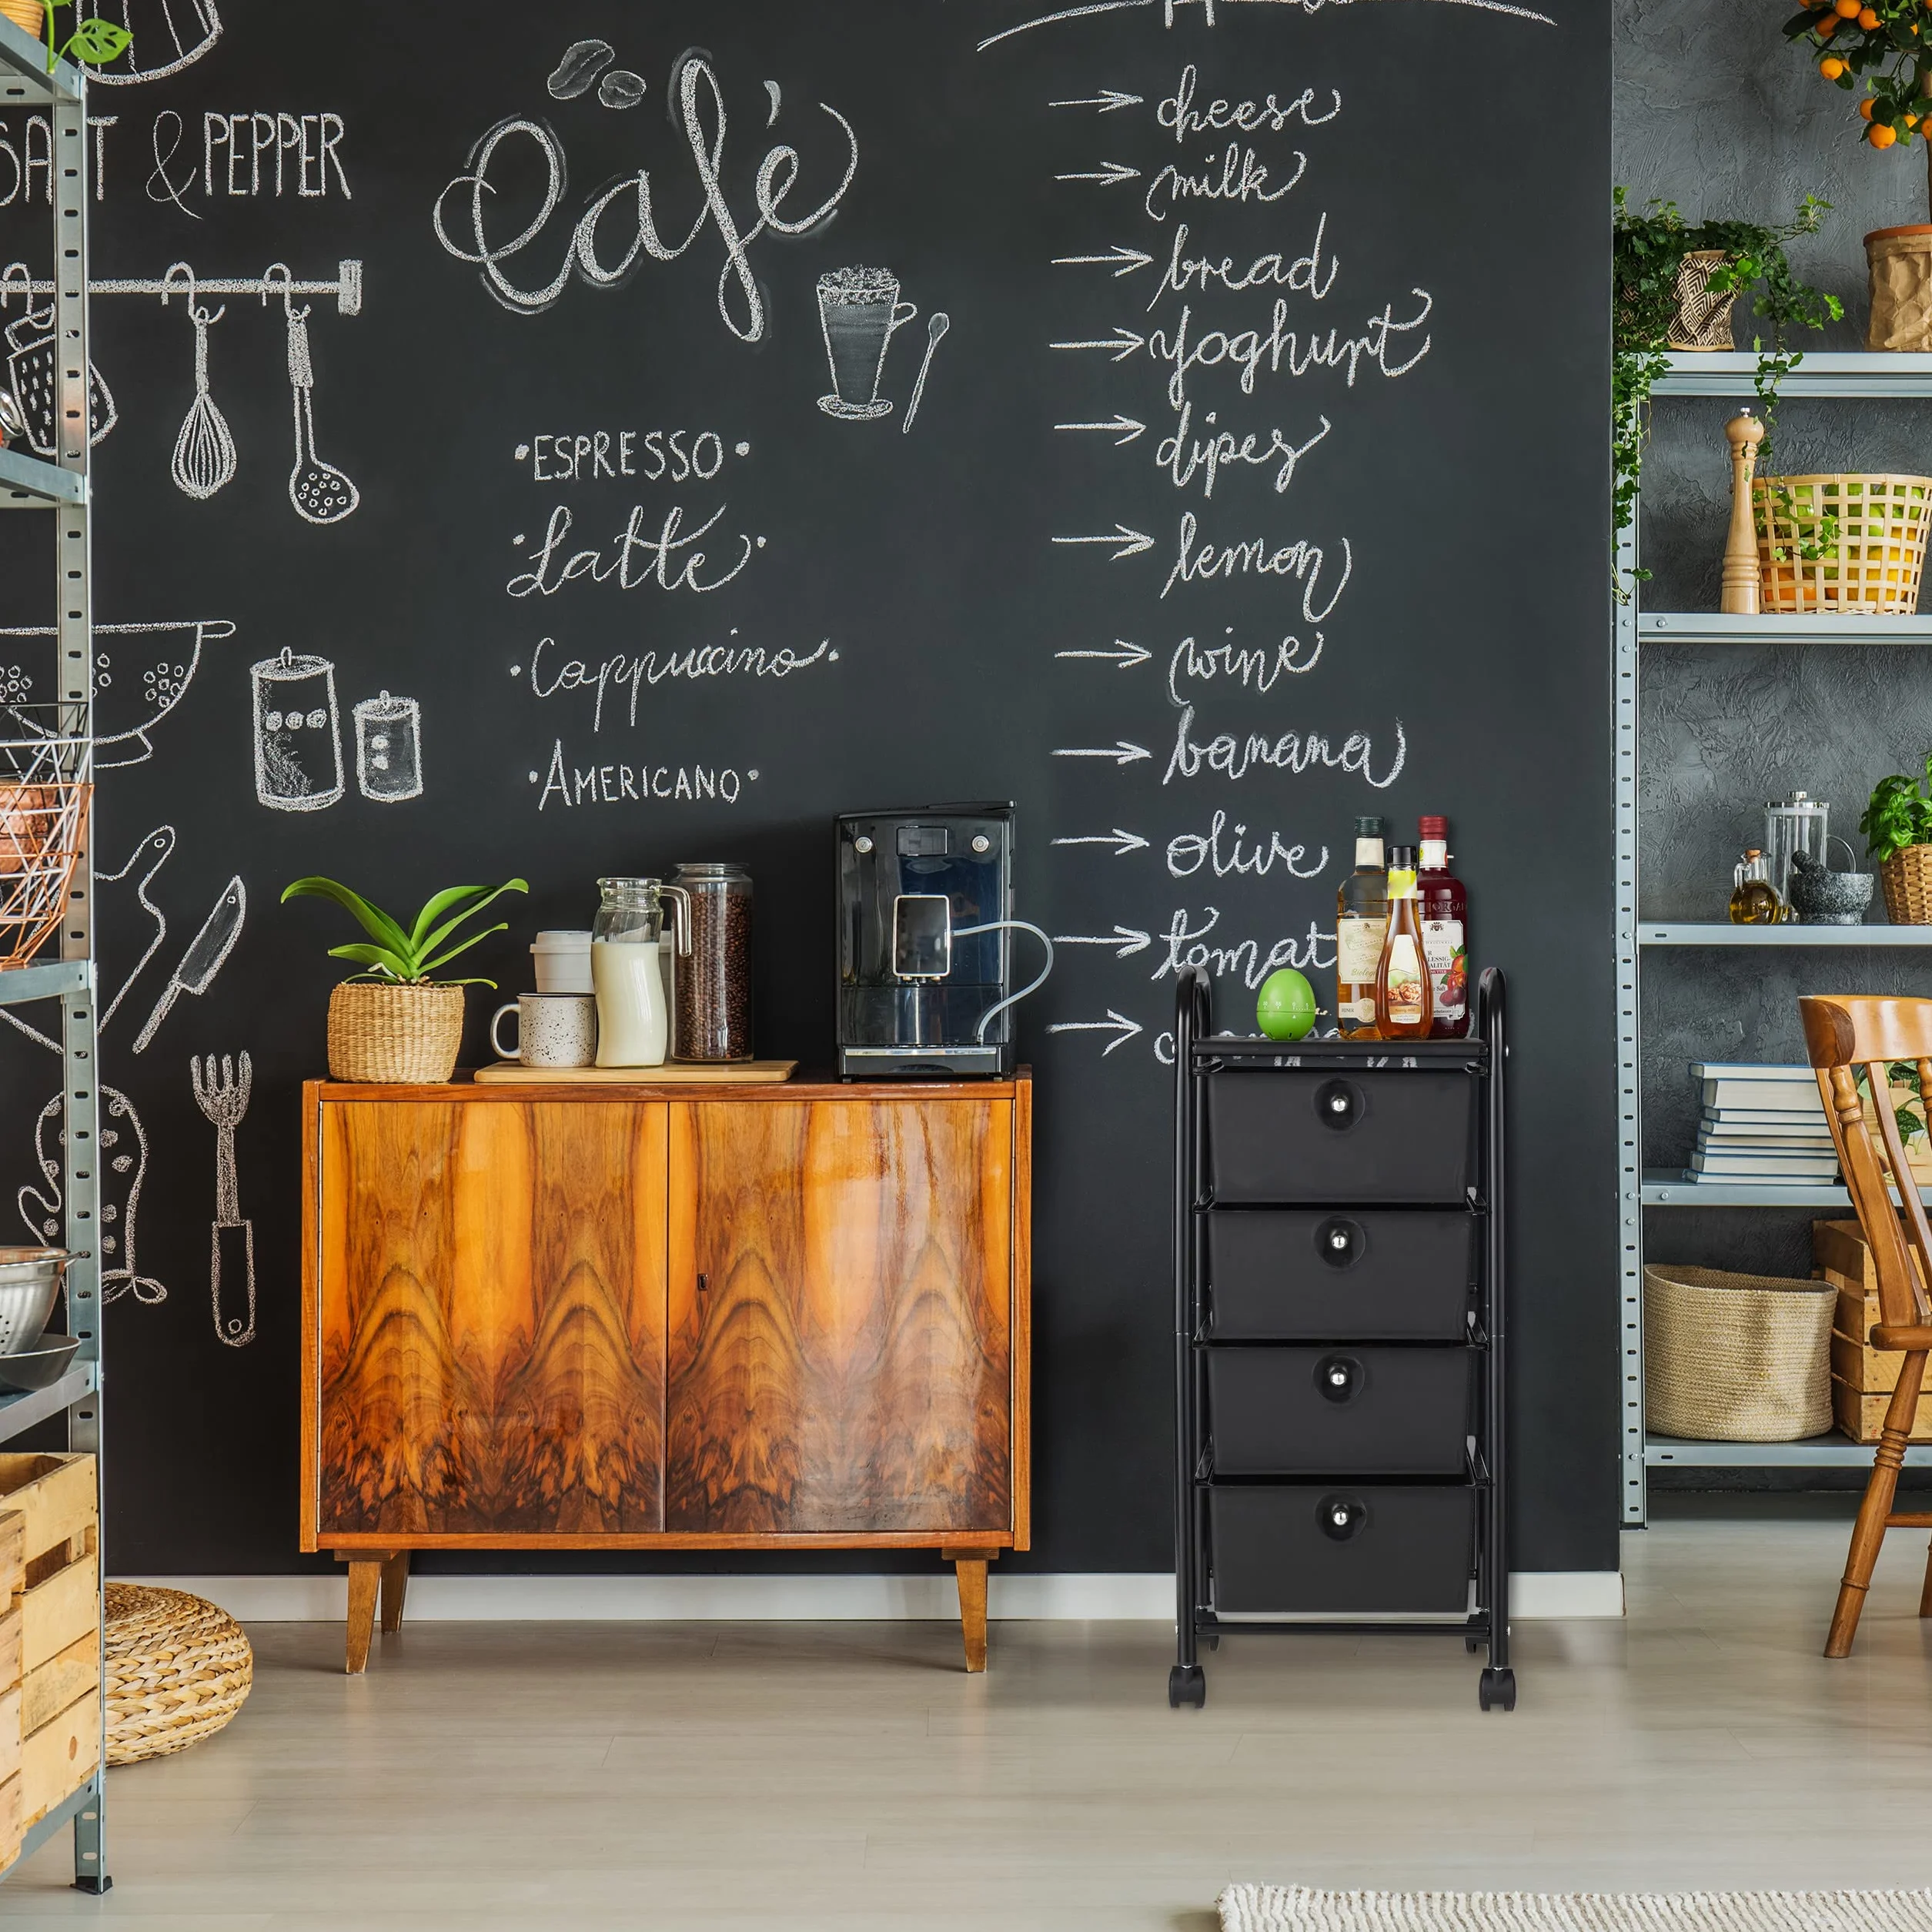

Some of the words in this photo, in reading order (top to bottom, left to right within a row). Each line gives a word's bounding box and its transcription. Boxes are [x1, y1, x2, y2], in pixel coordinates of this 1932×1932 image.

[1157, 65, 1341, 143] cheese
[0, 115, 119, 206] SAT
[146, 110, 202, 219] &
[204, 112, 351, 199] PEPPER
[1146, 142, 1307, 221] milk
[1147, 212, 1338, 312] bread
[534, 430, 724, 482] ESPRESSO
[506, 505, 751, 597] Latte
[1160, 512, 1352, 623] lemon
[1168, 627, 1324, 704] wine
[1162, 705, 1406, 788] banana
[1166, 810, 1329, 878] olive
[1151, 907, 1337, 990] tomat
